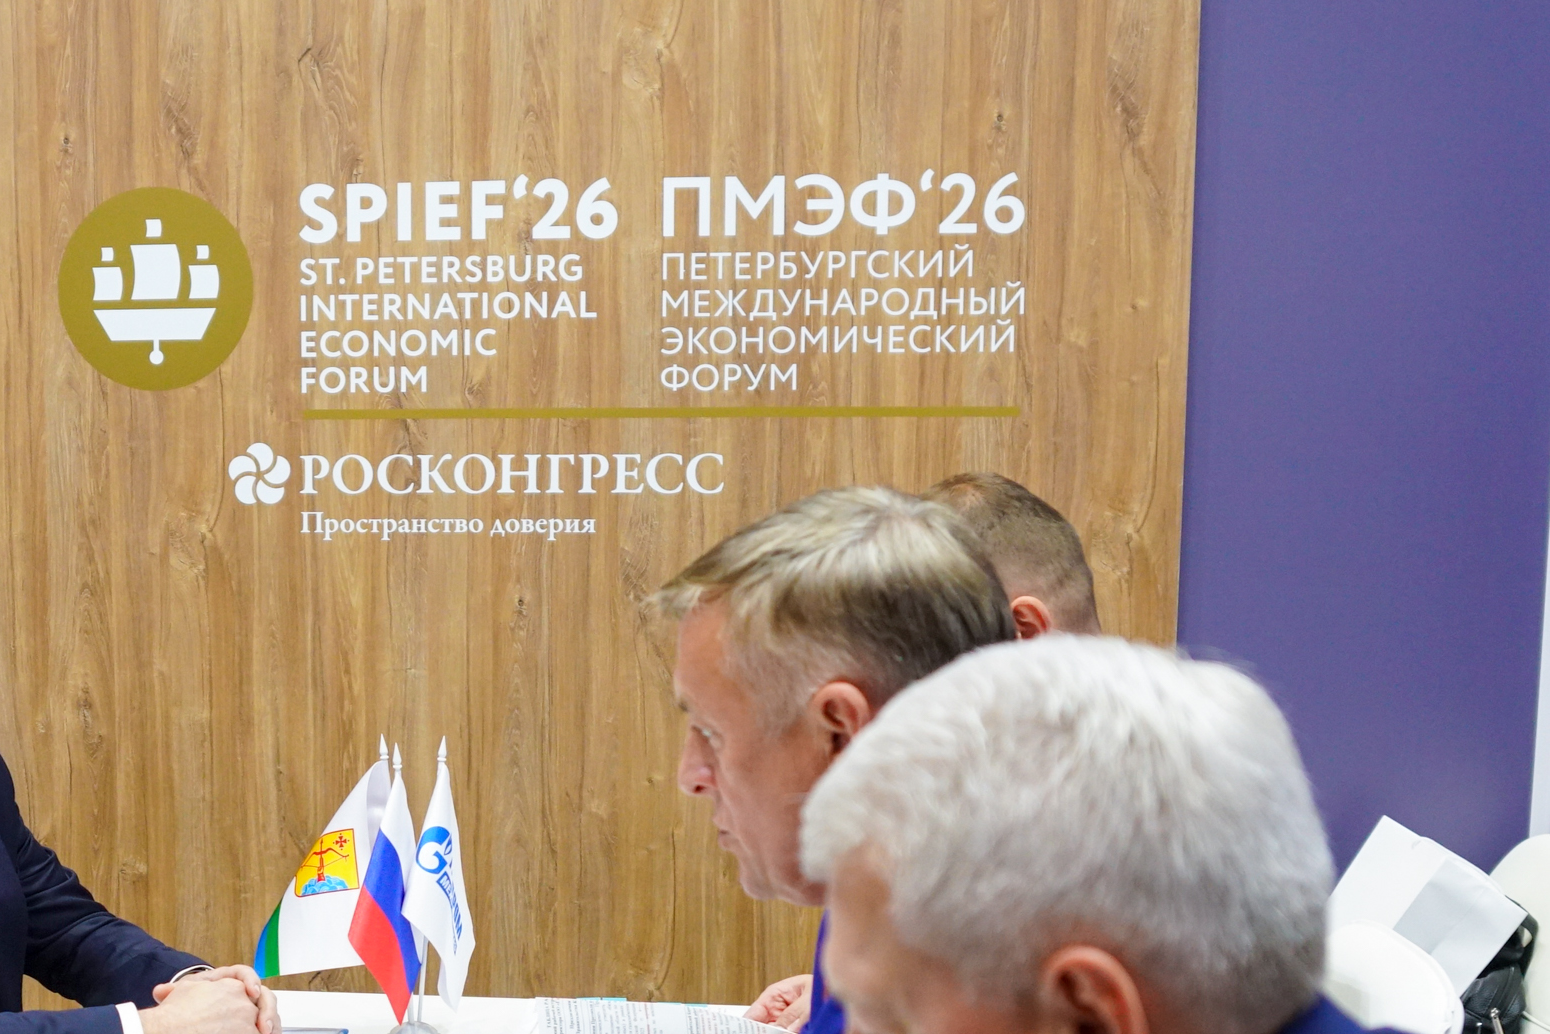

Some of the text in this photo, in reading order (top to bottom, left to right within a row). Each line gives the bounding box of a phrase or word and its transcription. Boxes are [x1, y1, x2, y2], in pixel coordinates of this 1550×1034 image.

[299, 253, 583, 286] ST. PETERSBURG
[662, 243, 975, 281] ПЕТЕРБУРГСКИЙ
[300, 290, 598, 322] INTERNATIONAL
[661, 280, 1026, 322] МЕЖДУНАРОДНЫЙ
[300, 328, 497, 358] ECONOMIC
[660, 318, 1016, 355] ЭКОНОМИЧЕСКИЙ
[300, 365, 428, 394] FORUM
[660, 363, 797, 392] ФОРУМ
[299, 452, 725, 495] РОСКОНГРЕСС
[300, 511, 597, 541] Пространство доверия
